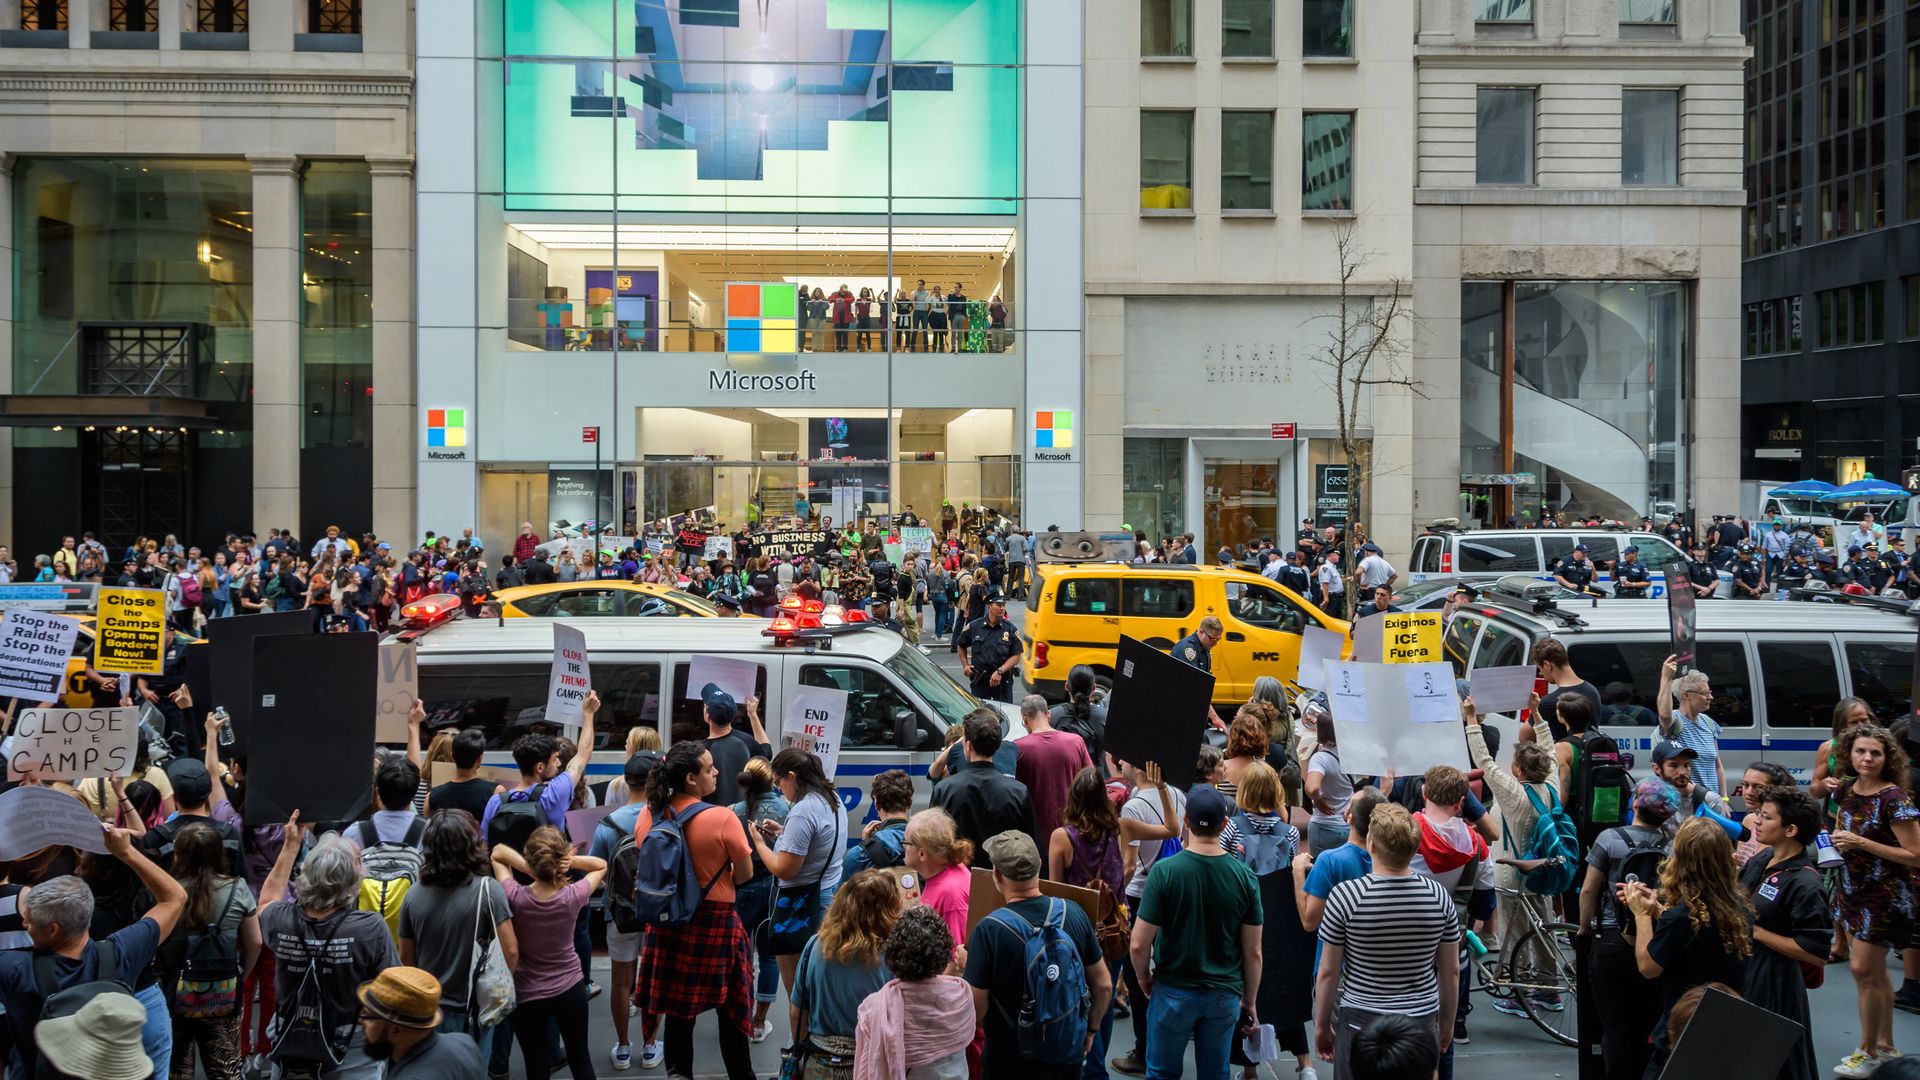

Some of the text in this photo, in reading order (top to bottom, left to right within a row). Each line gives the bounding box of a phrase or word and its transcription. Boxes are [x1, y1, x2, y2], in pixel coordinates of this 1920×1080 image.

[709, 370, 816, 390] Microsoft
[1769, 430, 1802, 440] ROLEX
[428, 451, 466, 460] Microsoft
[752, 532, 826, 545] NO BUSINESS
[760, 544, 786, 556] WITH
[107, 595, 156, 606] Close
[11, 614, 69, 631] Stop the
[106, 618, 160, 630] Camps
[1385, 618, 1436, 629] Exigimos
[13, 626, 60, 643] Raids!
[104, 630, 136, 640] Open
[1395, 633, 1418, 644] ICE
[3, 638, 66, 656] Stop the
[106, 639, 158, 650] Borders
[114, 649, 144, 658] Now!
[562, 648, 584, 662] CLOSE
[1252, 652, 1280, 661] NYC
[1390, 648, 1429, 658] Fuera
[567, 662, 581, 674] THE
[75, 676, 87, 691] T
[560, 674, 587, 688] TRUMP
[804, 708, 828, 722] END
[19, 710, 123, 738] CLOSE
[804, 724, 824, 738] ICE
[34, 734, 101, 748] THE
[12, 746, 127, 774] CAMPS
